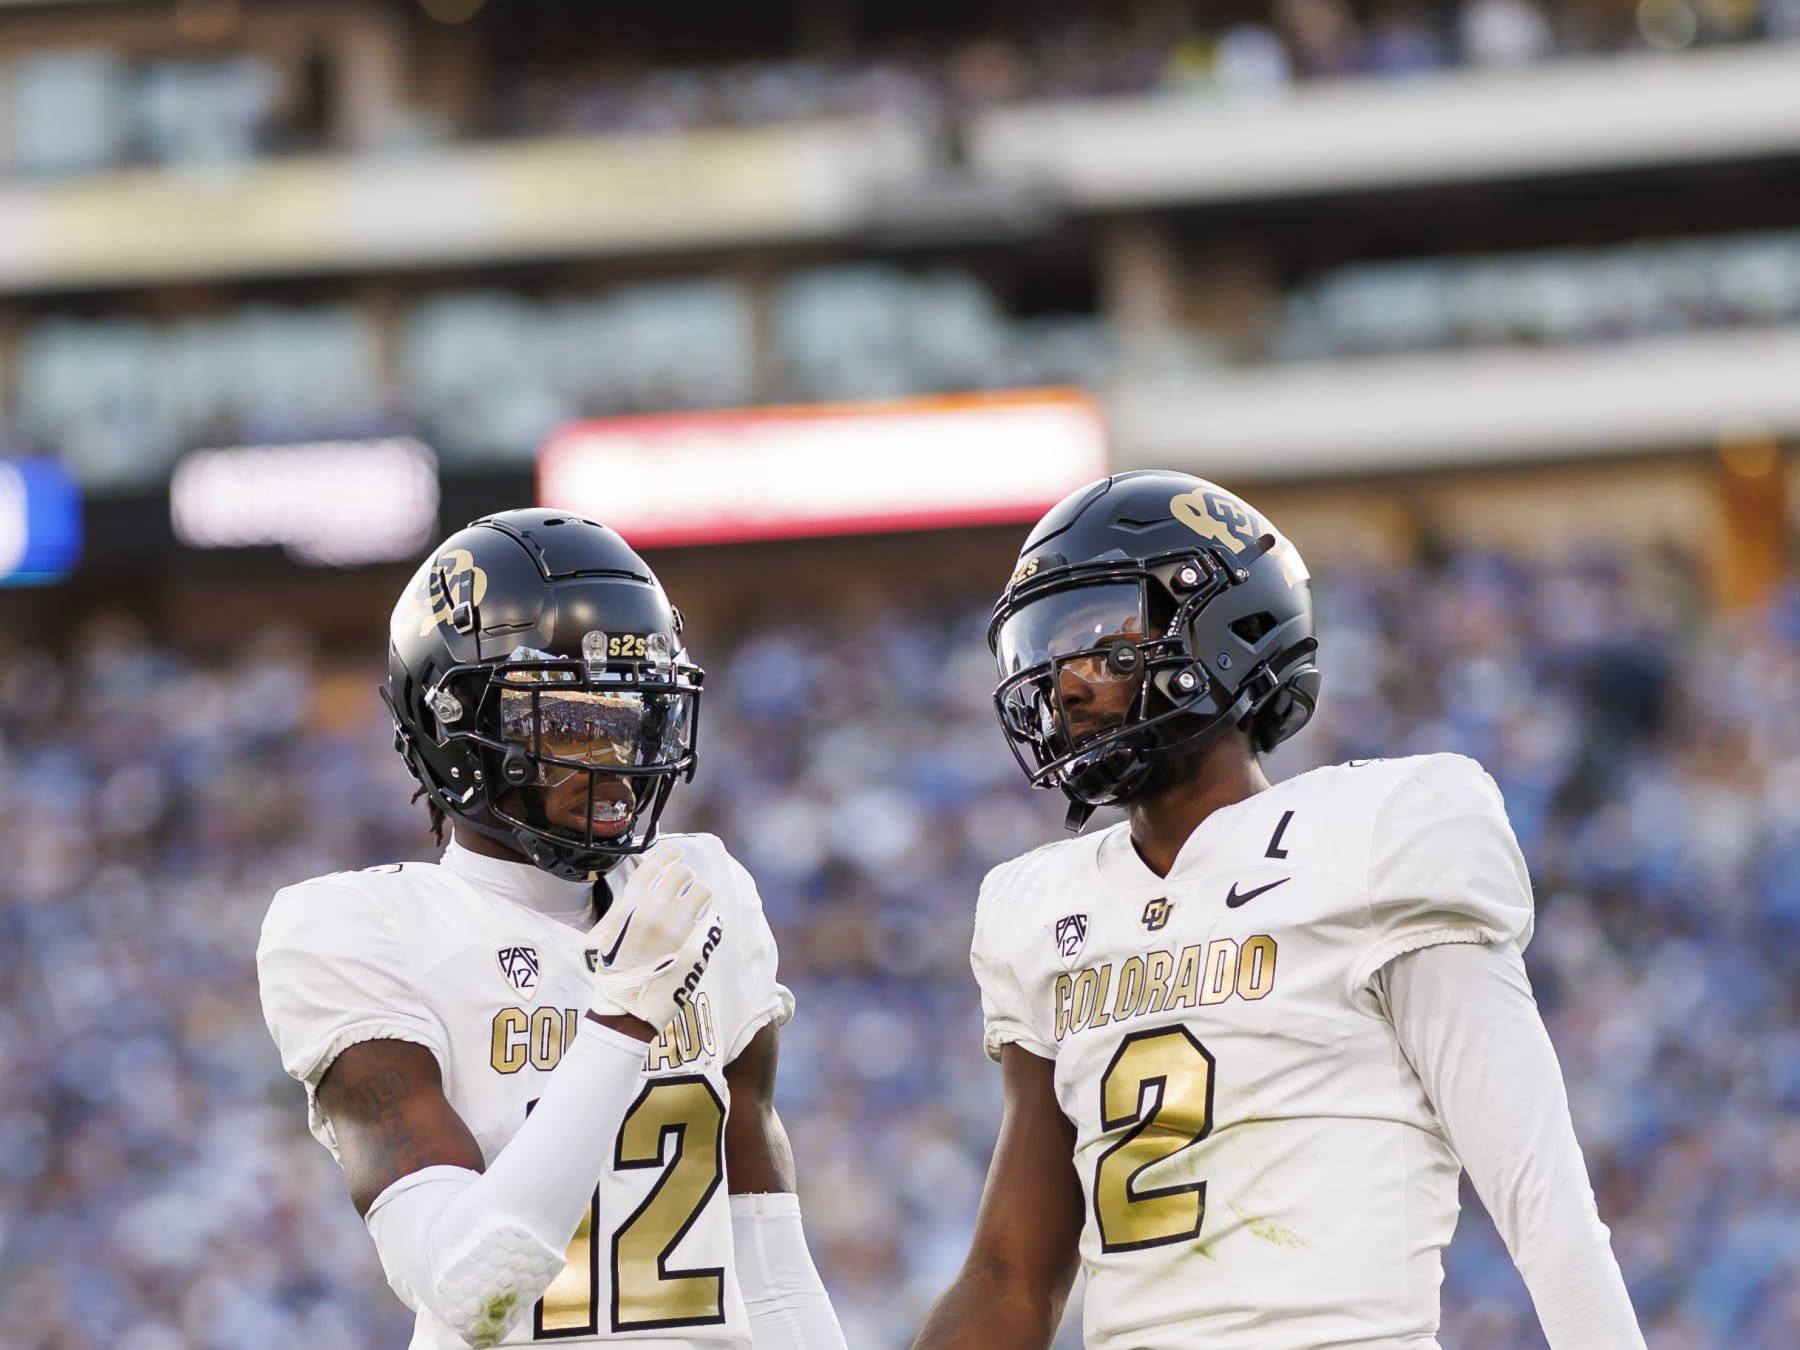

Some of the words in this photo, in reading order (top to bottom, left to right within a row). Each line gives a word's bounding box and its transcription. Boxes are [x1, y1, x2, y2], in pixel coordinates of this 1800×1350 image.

[1264, 810, 1295, 859] L
[1056, 914, 1088, 948] PAC
[1141, 897, 1174, 931] CU
[498, 946, 539, 978] PAC
[1061, 935, 1079, 957] 12
[512, 967, 536, 989] 12
[1054, 934, 1278, 1042] COLORADO
[1093, 1023, 1216, 1254] 2
